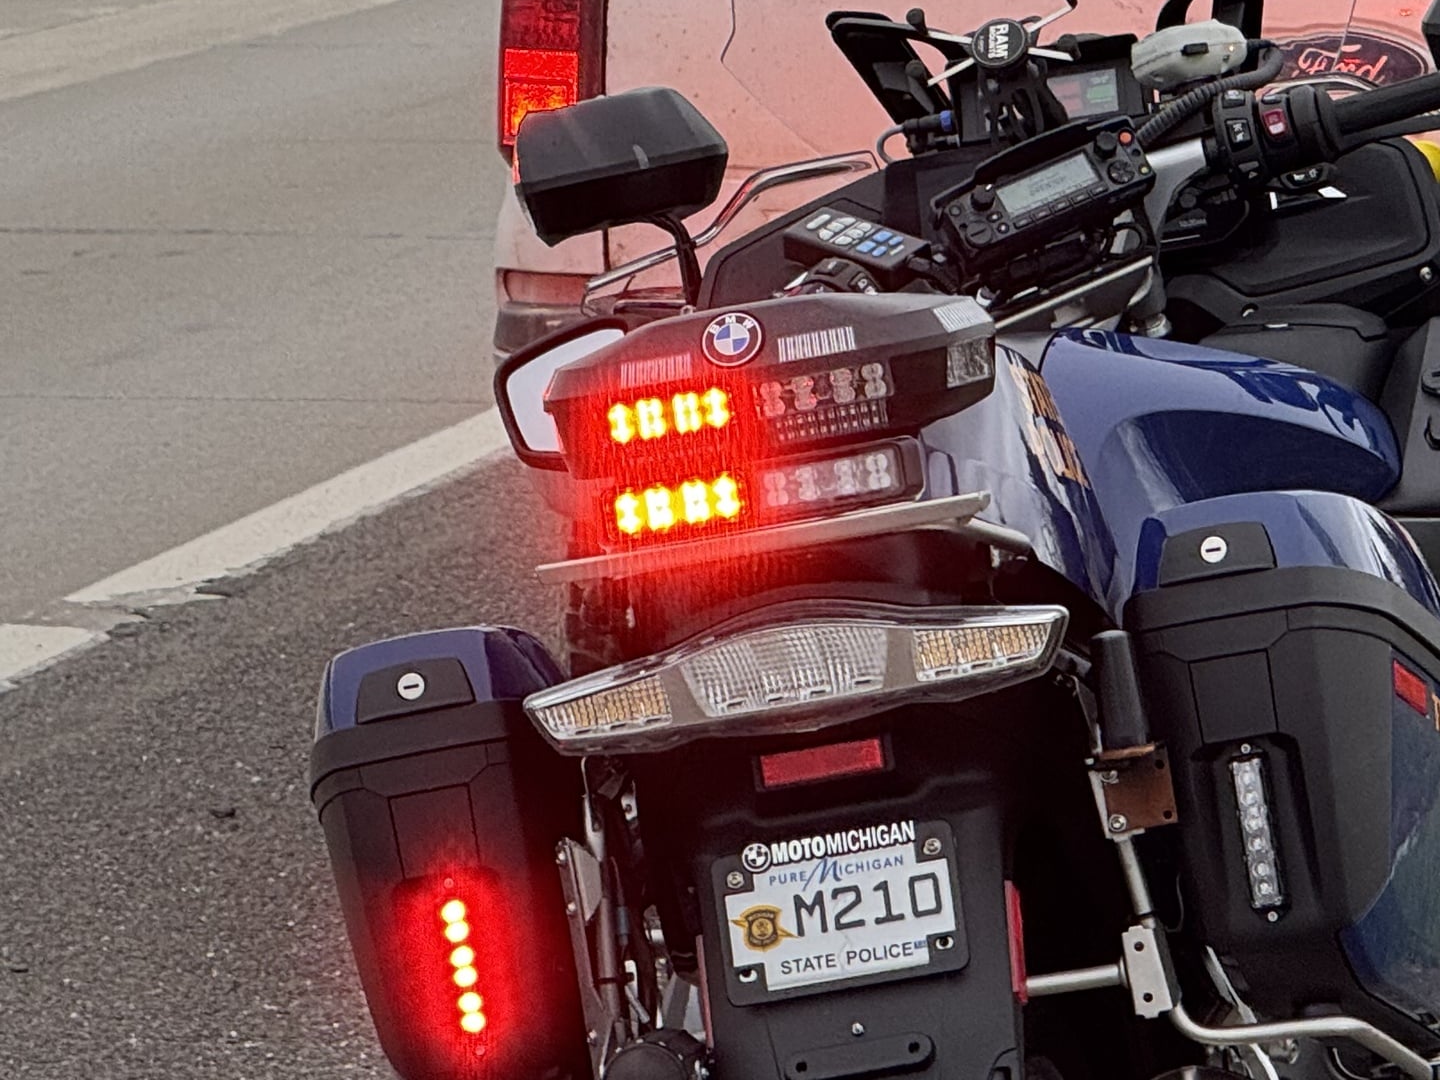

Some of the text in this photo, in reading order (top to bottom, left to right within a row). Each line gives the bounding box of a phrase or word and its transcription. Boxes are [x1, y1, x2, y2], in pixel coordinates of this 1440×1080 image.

[994, 23, 1009, 58] RAM
[708, 315, 755, 335] BMW
[771, 820, 916, 865] MOTOMICHIGAN
[768, 855, 905, 892] PURE MICHIGAN
[793, 872, 943, 938] M210
[780, 953, 837, 976] STATE
[846, 941, 914, 966] POLICE
